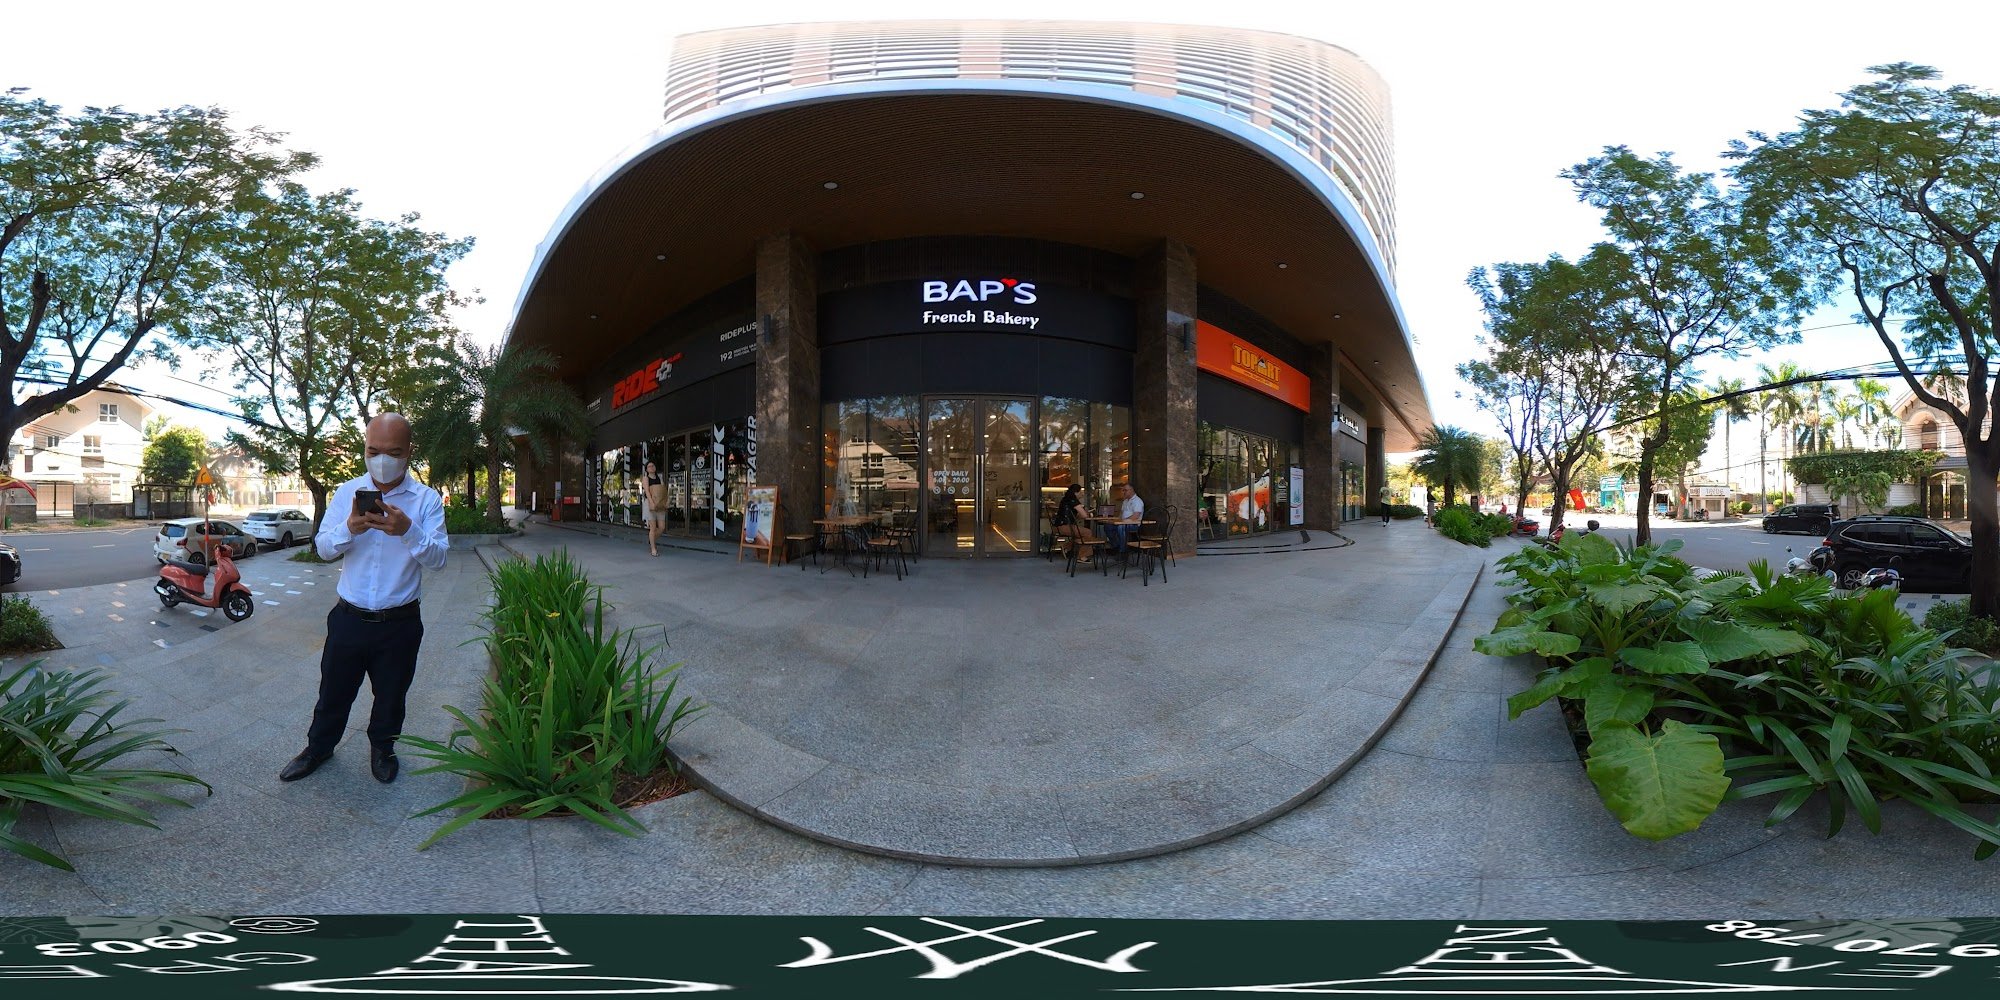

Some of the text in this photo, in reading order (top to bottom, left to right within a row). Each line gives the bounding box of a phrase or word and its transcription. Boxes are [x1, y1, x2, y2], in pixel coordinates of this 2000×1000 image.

[923, 279, 1037, 305] BAP'S
[923, 310, 1040, 330] French Bakery
[720, 321, 757, 343] RIDEPLUS
[720, 350, 733, 362] 192
[713, 423, 725, 537] TREK
